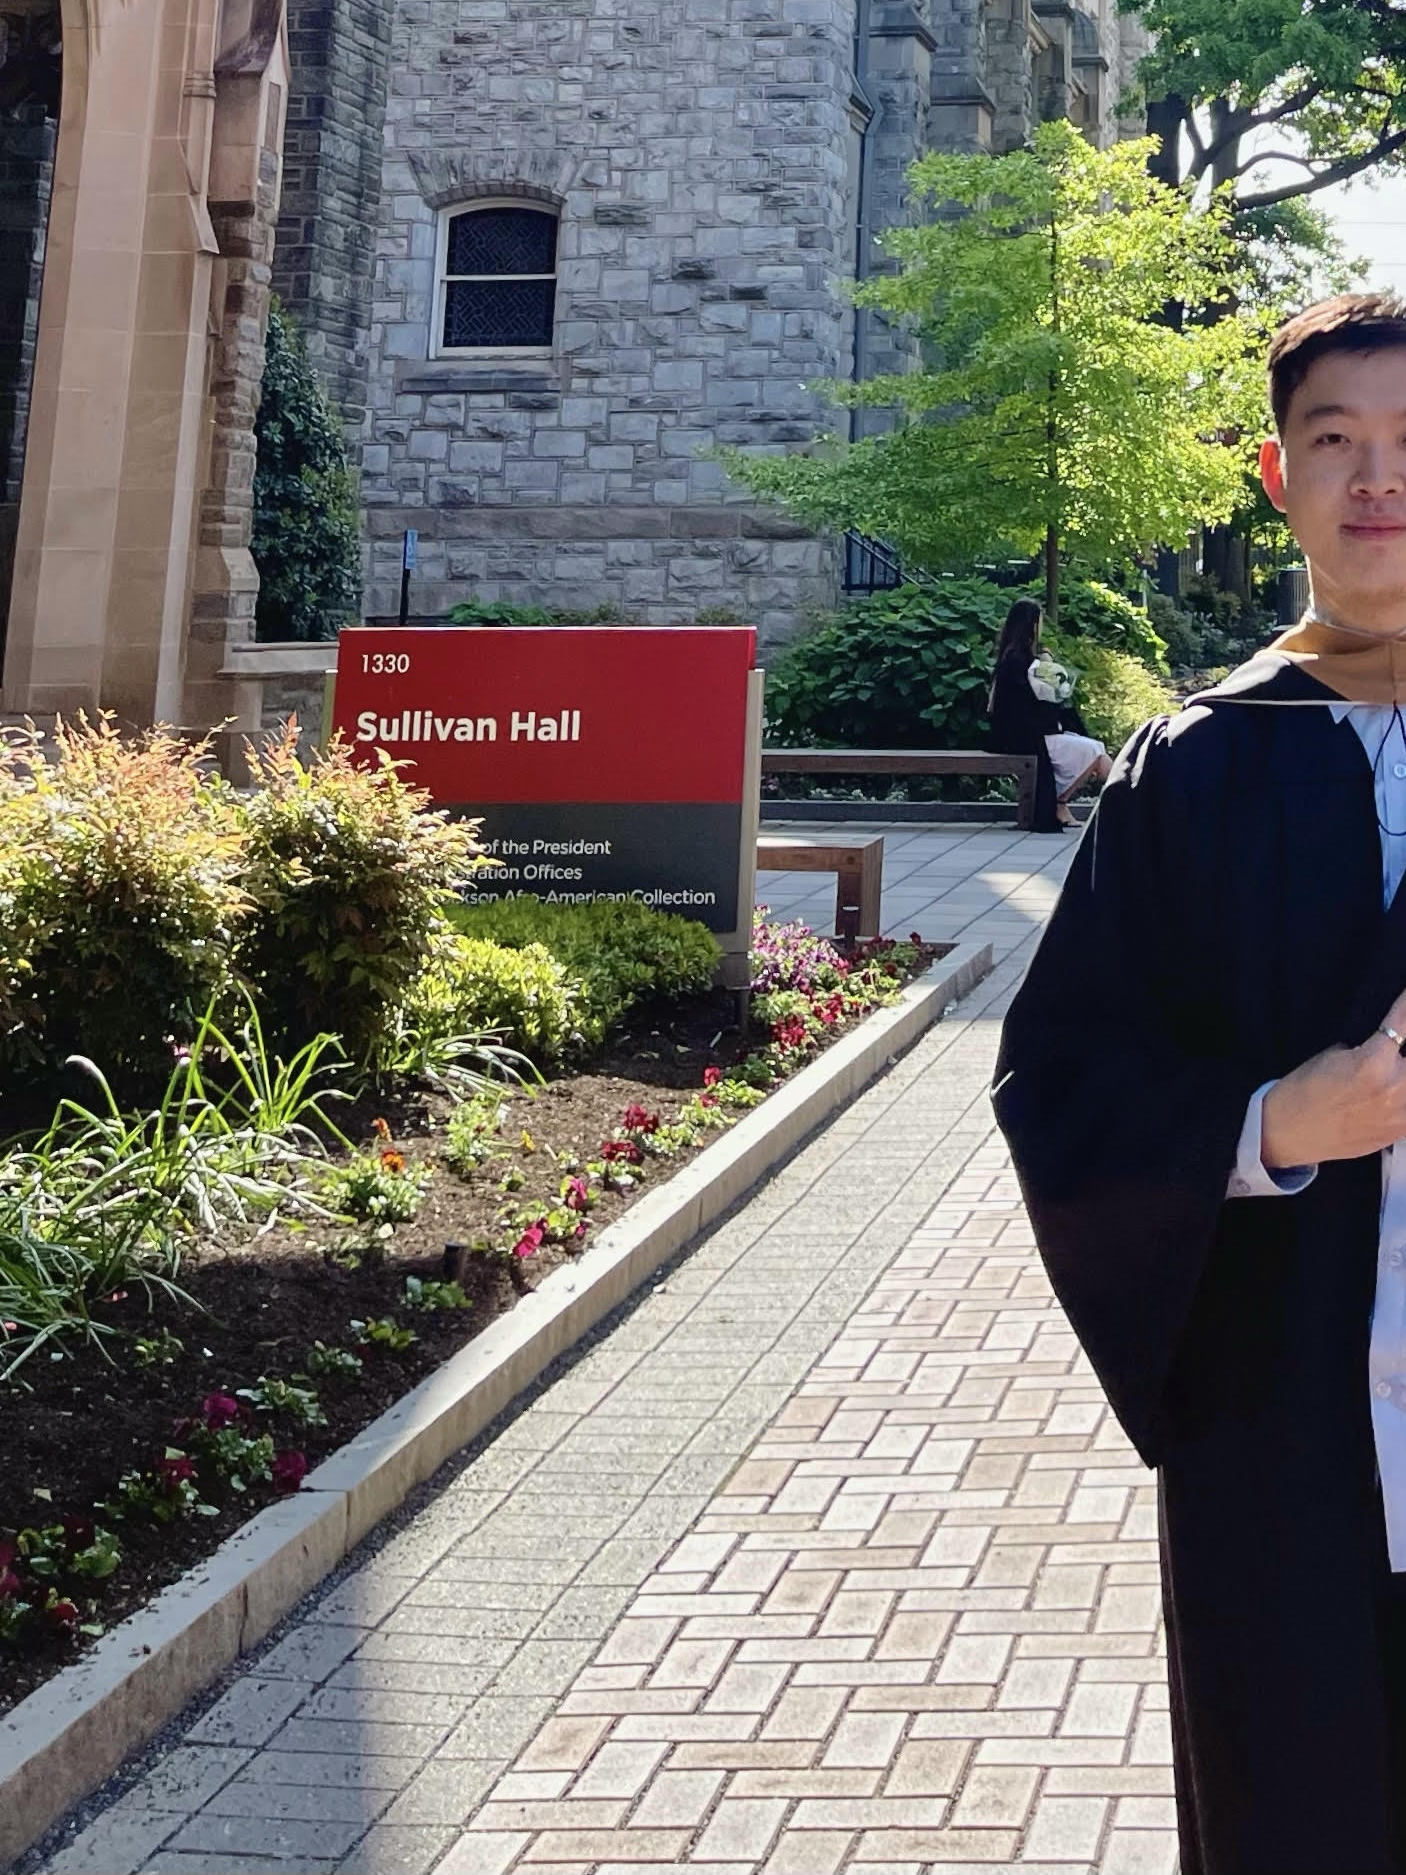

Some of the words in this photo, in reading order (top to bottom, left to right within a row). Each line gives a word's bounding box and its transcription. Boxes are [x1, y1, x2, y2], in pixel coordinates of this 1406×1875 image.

[361, 653, 411, 674] 1330
[355, 710, 498, 742] Sullivan
[510, 710, 581, 742] Hall
[482, 839, 500, 855] of
[502, 839, 530, 855] the
[533, 838, 612, 855] President
[523, 864, 583, 880] Offices
[631, 888, 716, 905] Collection
